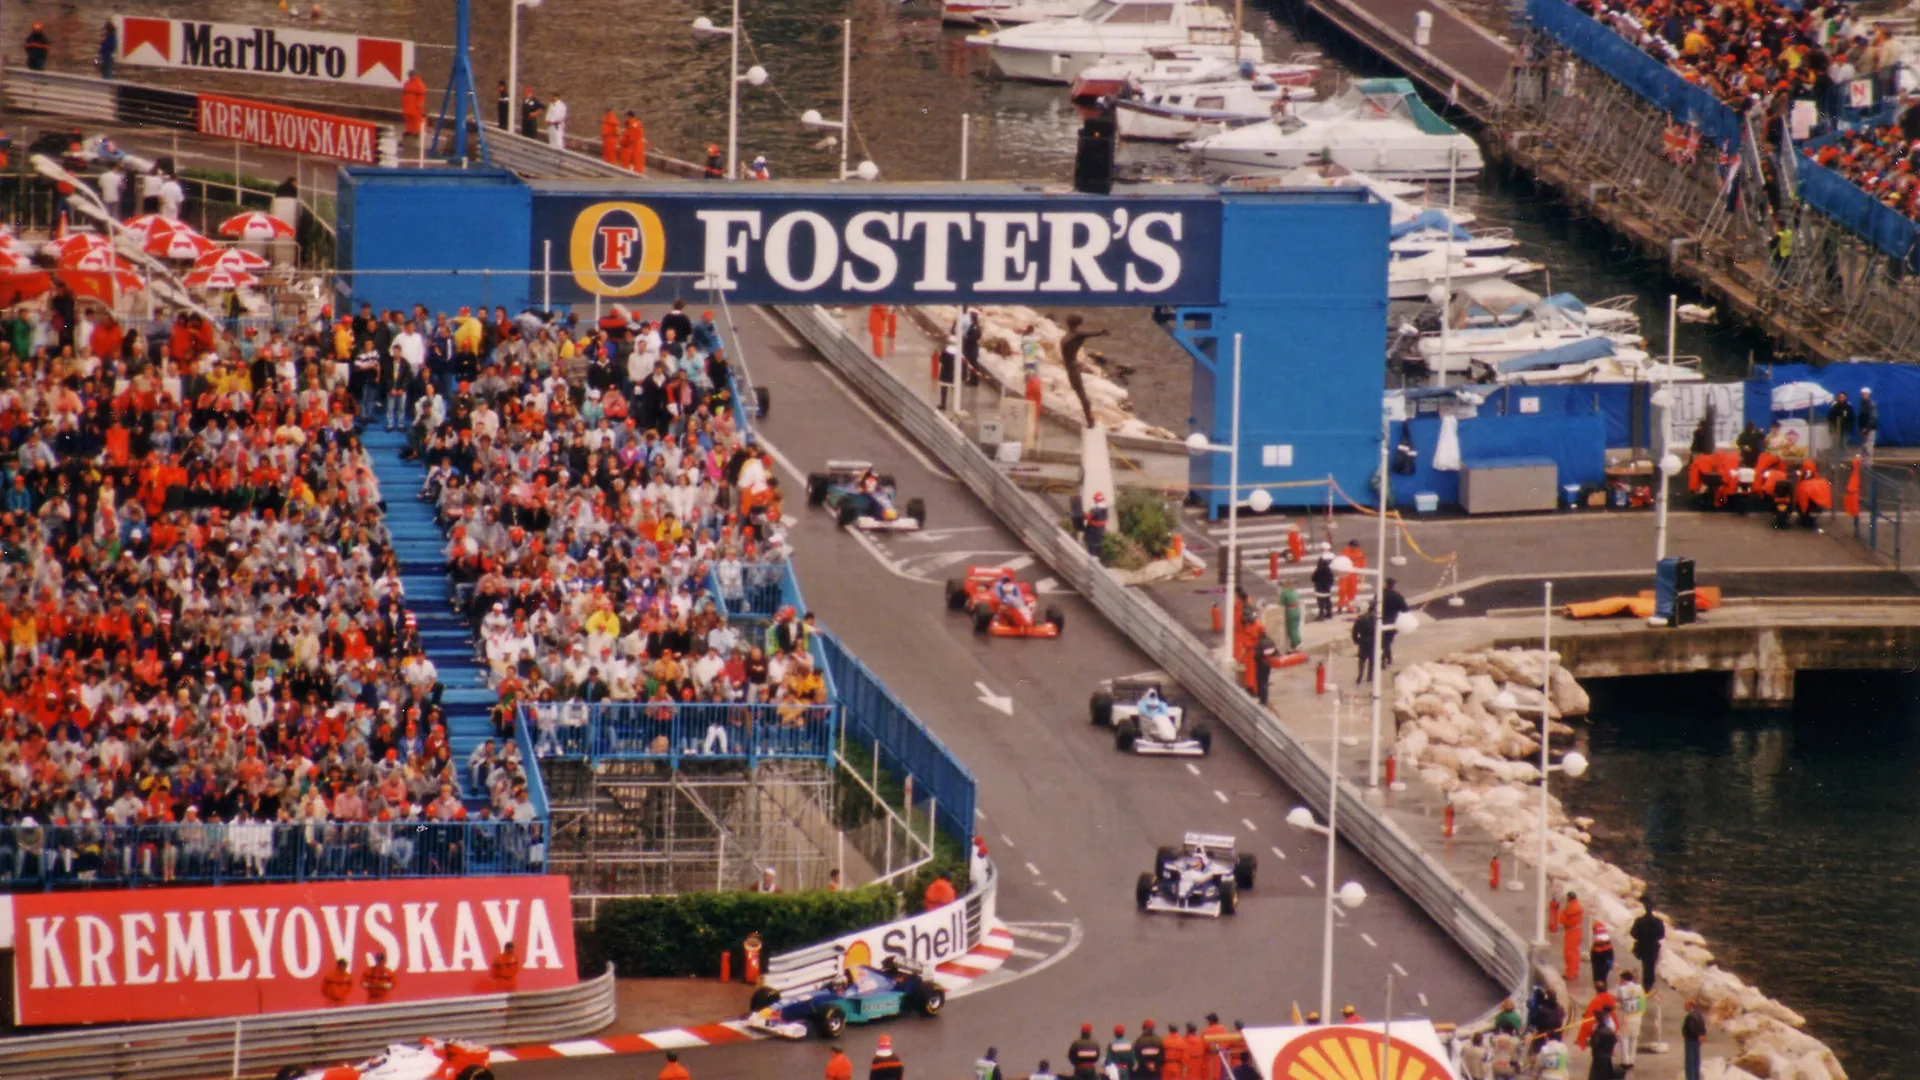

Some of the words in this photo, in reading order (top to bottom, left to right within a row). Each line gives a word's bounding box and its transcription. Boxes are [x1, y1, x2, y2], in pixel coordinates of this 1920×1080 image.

[182, 22, 346, 78] Marlboro
[201, 101, 372, 162] KREMLYOVSKAYA
[694, 207, 1184, 293] FOSTER'S
[27, 899, 563, 988] KREMLYOVSKAYA
[882, 910, 963, 961] Shell
